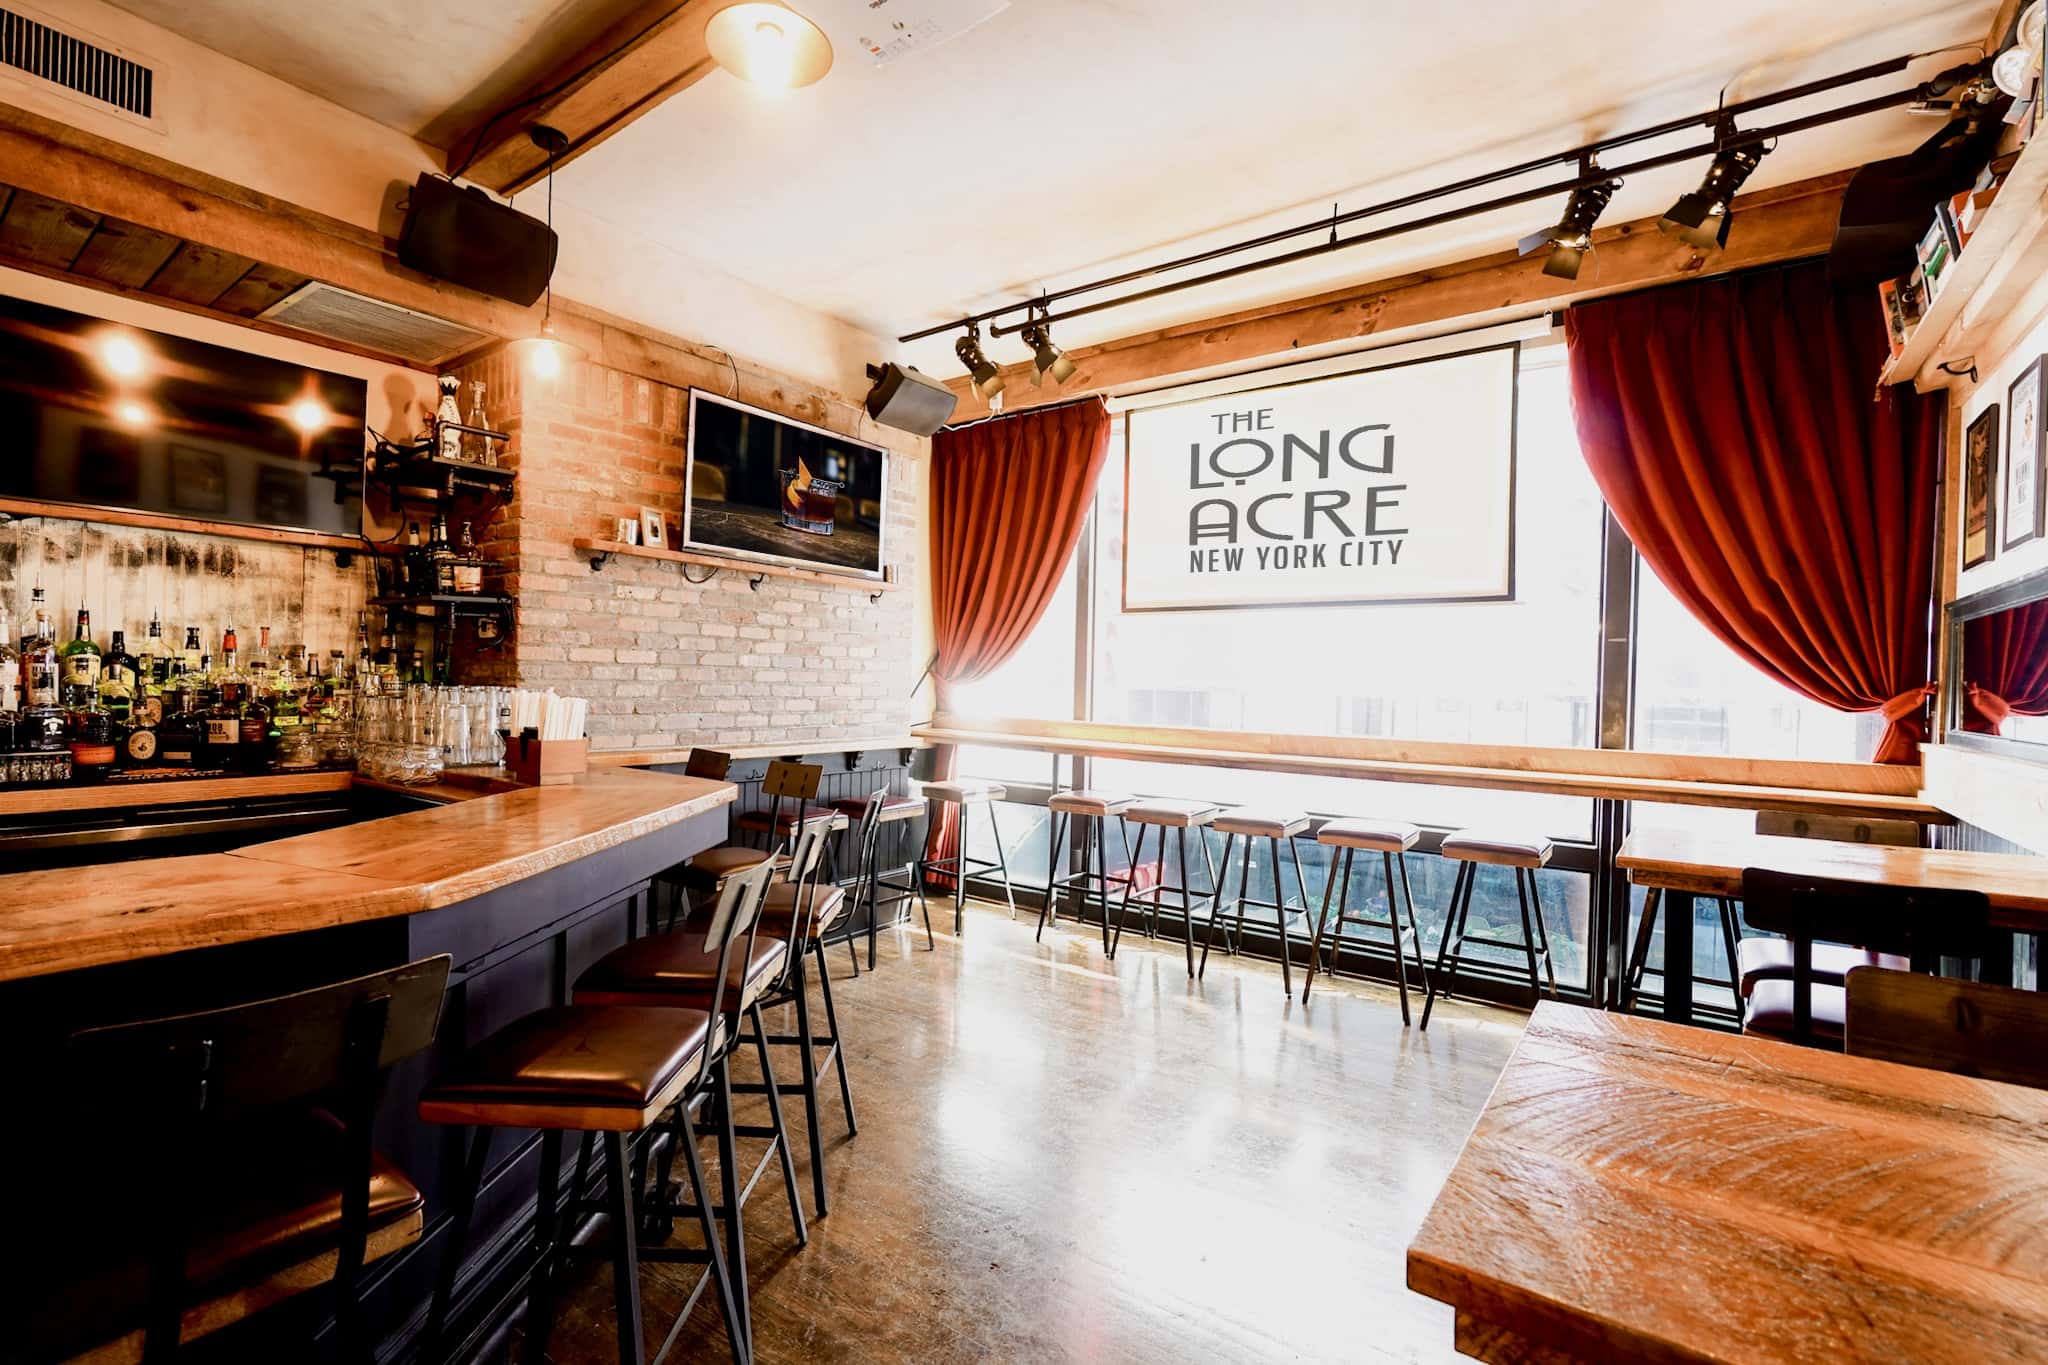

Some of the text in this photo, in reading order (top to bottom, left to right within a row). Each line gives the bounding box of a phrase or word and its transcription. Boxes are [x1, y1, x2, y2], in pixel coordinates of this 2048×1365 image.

[1211, 408, 1274, 434] THE
[1190, 424, 1395, 489] LONG
[1189, 485, 1409, 546] ACRE
[1190, 540, 1403, 573] NEW YORK CITY
